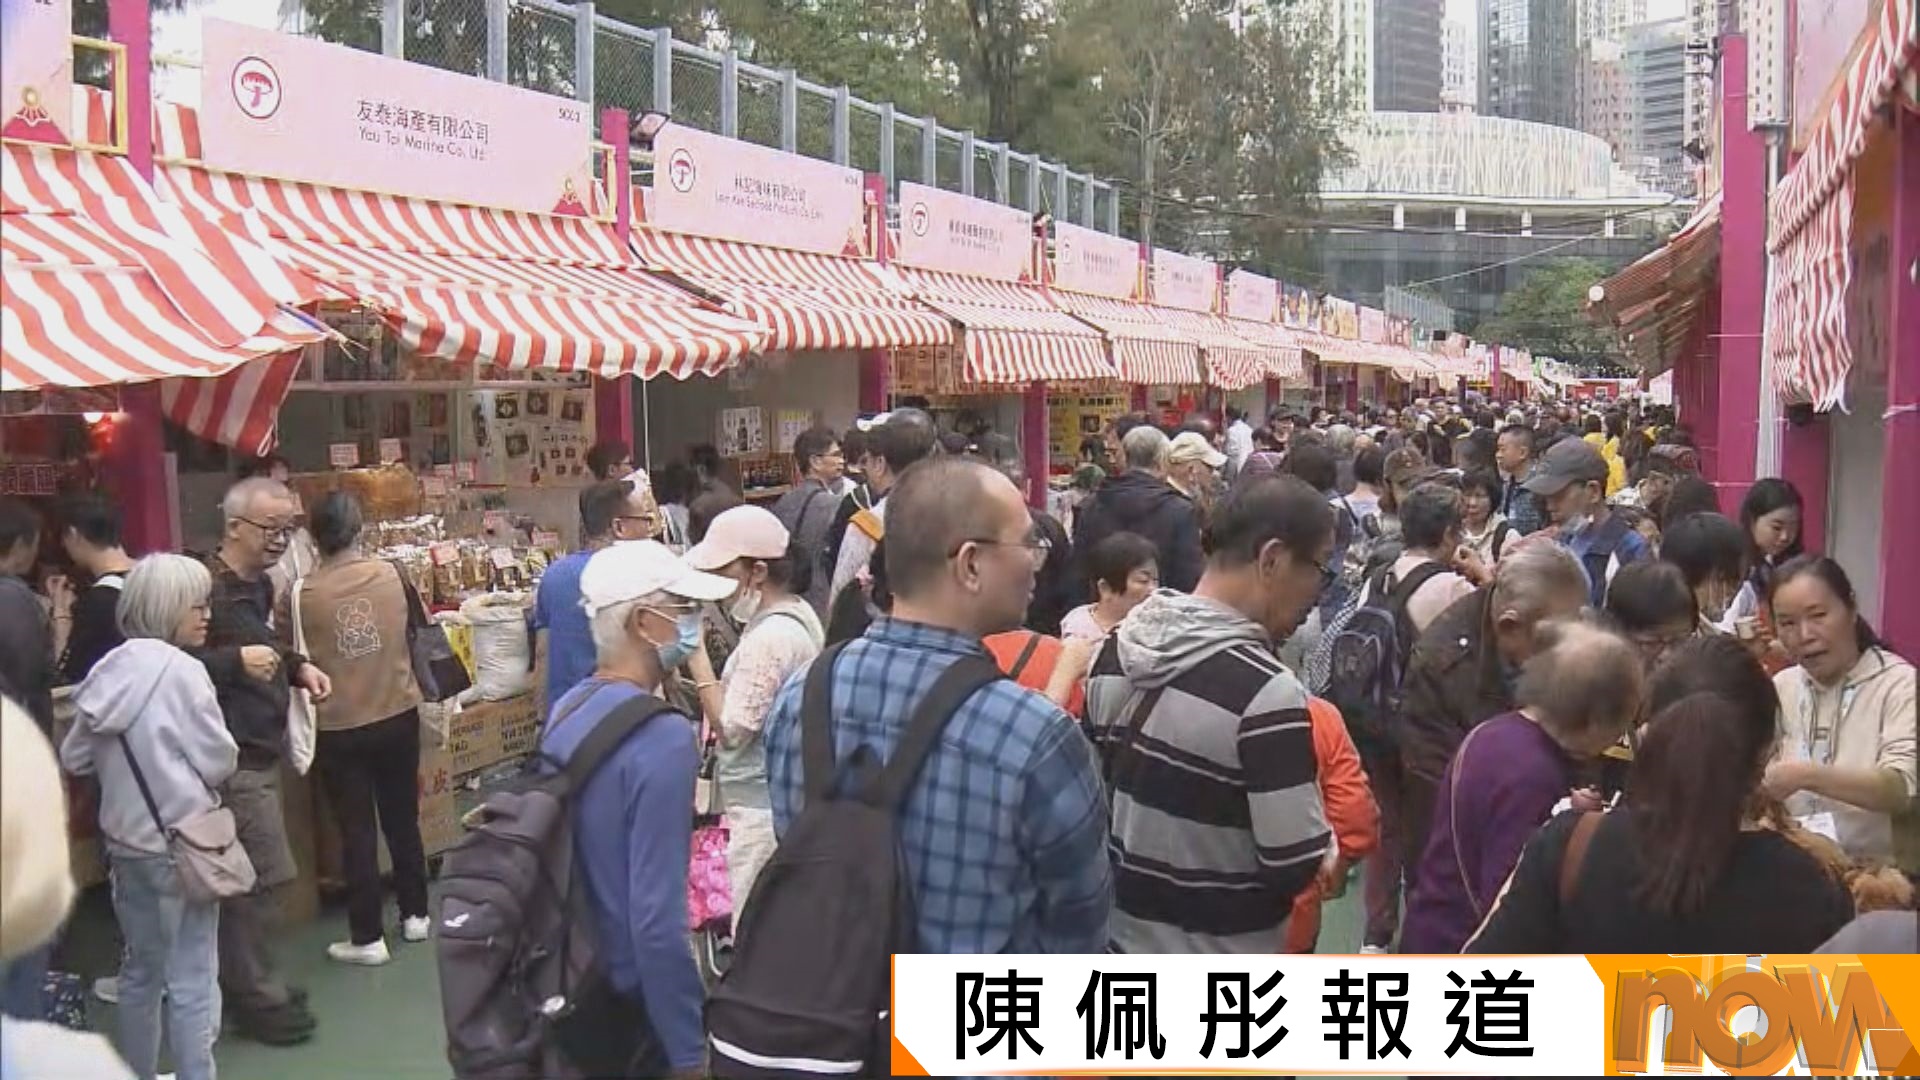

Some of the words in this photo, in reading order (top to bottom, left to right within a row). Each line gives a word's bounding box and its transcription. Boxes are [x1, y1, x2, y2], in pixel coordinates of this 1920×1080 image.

[357, 100, 489, 145] 友泰海產有限公司
[404, 135, 444, 153] Marine
